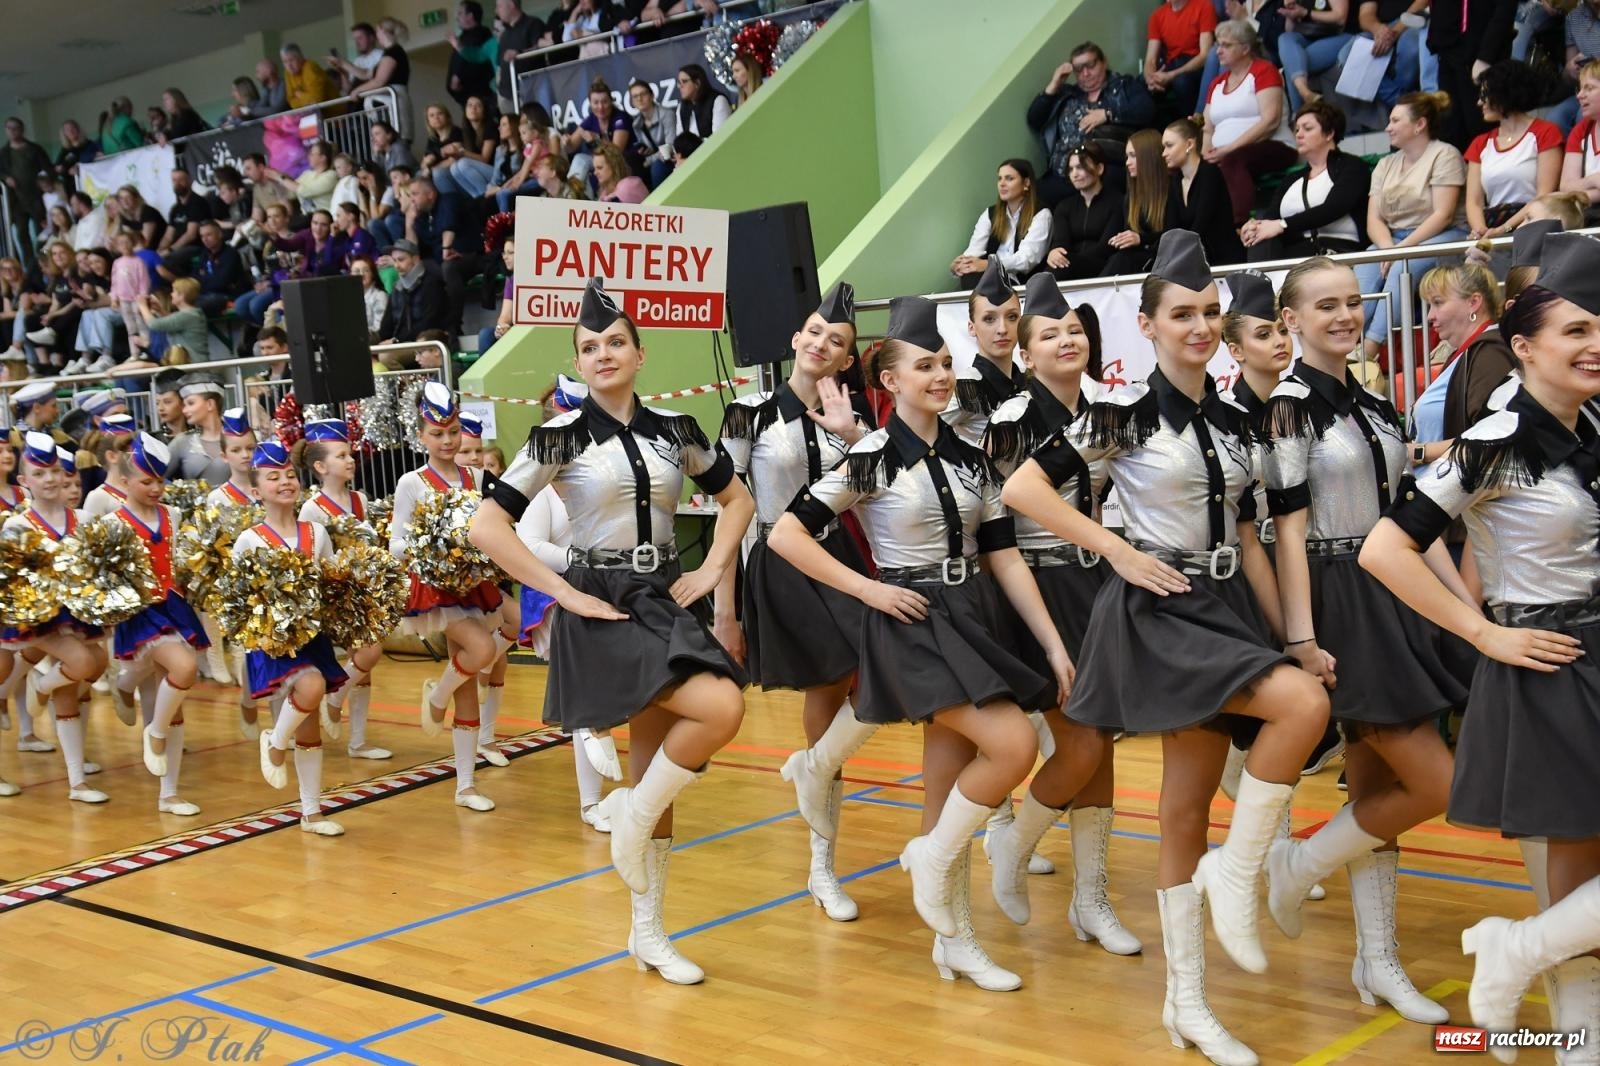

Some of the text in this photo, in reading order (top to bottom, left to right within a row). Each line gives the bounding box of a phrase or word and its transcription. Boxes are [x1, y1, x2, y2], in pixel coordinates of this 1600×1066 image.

[568, 206, 683, 234] MAŻORETKI
[534, 238, 713, 283] PANTERY
[527, 294, 711, 322] Gliw Poland
